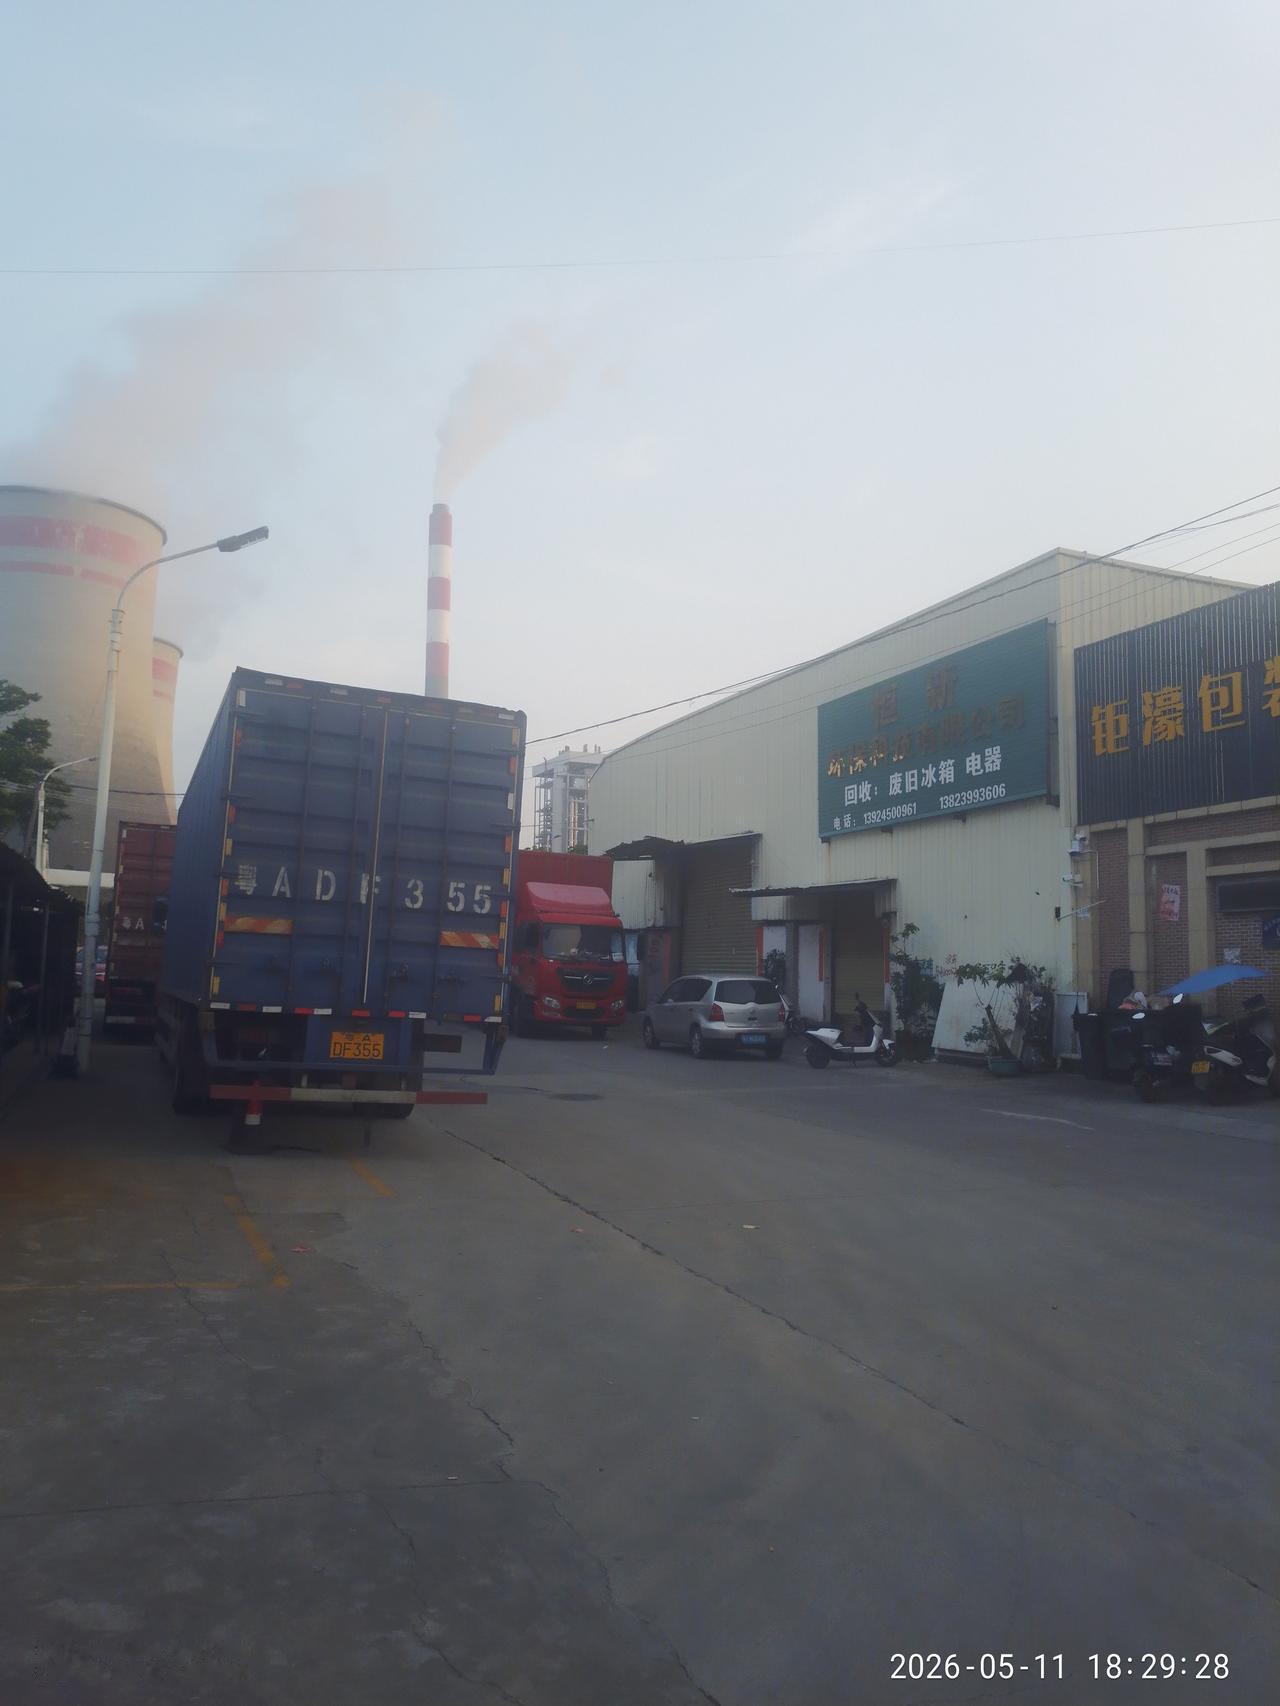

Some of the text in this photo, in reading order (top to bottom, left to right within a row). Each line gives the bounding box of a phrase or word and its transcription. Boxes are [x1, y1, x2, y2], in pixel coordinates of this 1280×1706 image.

[966, 745, 1002, 776] 电器
[863, 803, 917, 825] 13924500961
[939, 783, 1006, 810] 13823993606
[333, 1042, 381, 1058] DF355
